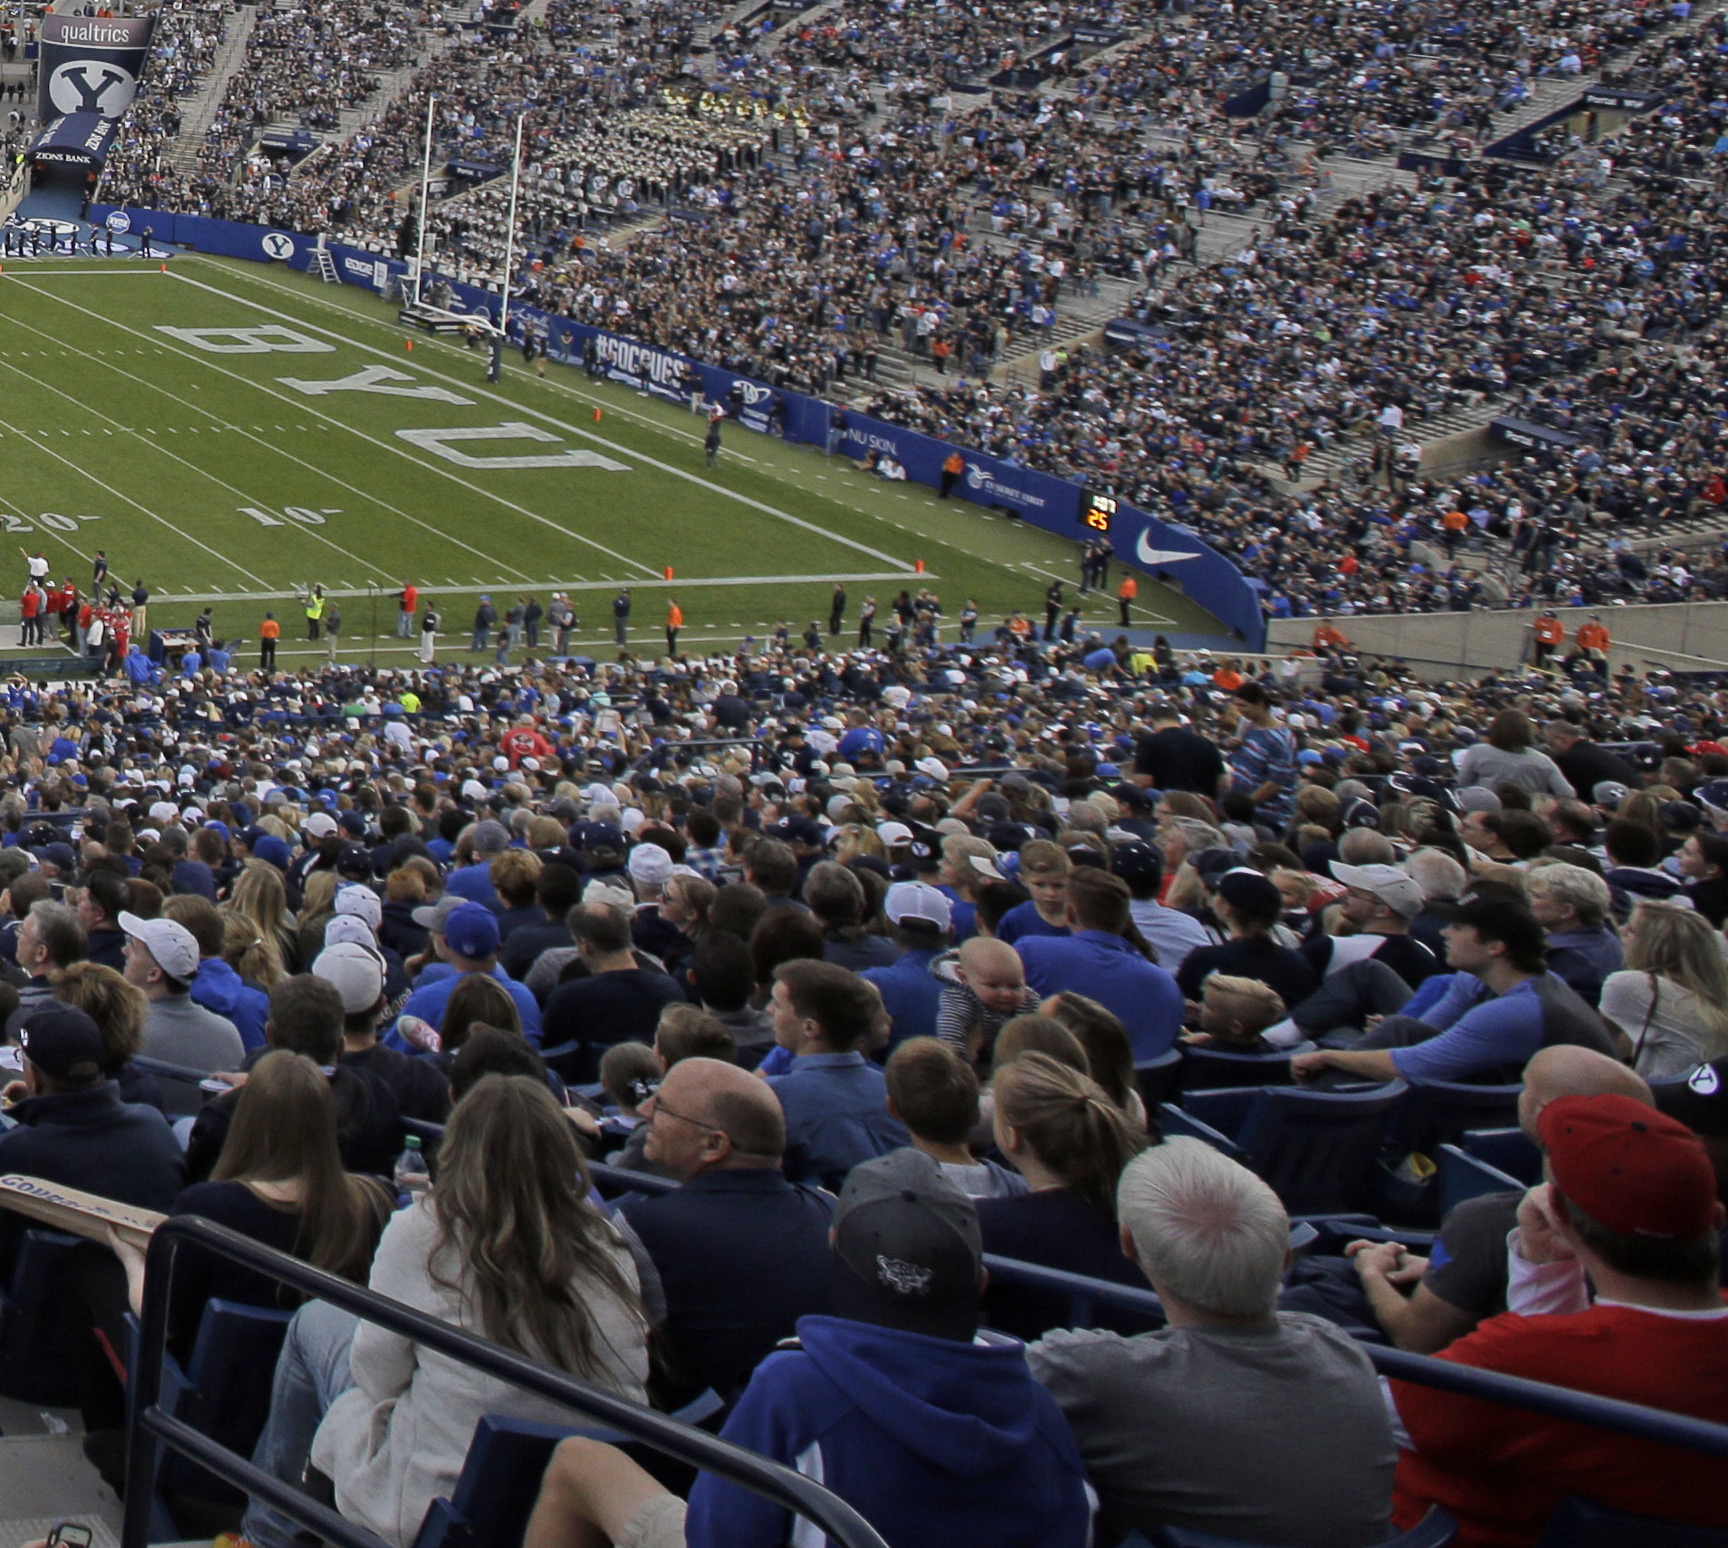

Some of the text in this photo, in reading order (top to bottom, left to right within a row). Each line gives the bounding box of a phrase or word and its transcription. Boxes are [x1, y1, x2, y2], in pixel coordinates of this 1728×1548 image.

[61, 23, 130, 44] qualtrics
[35, 152, 92, 164] ZIONS BANK
[153, 324, 633, 472] BYU
[849, 428, 897, 454] NU SKIN
[237, 505, 328, 527] 10
[1087, 508, 1109, 531] 25
